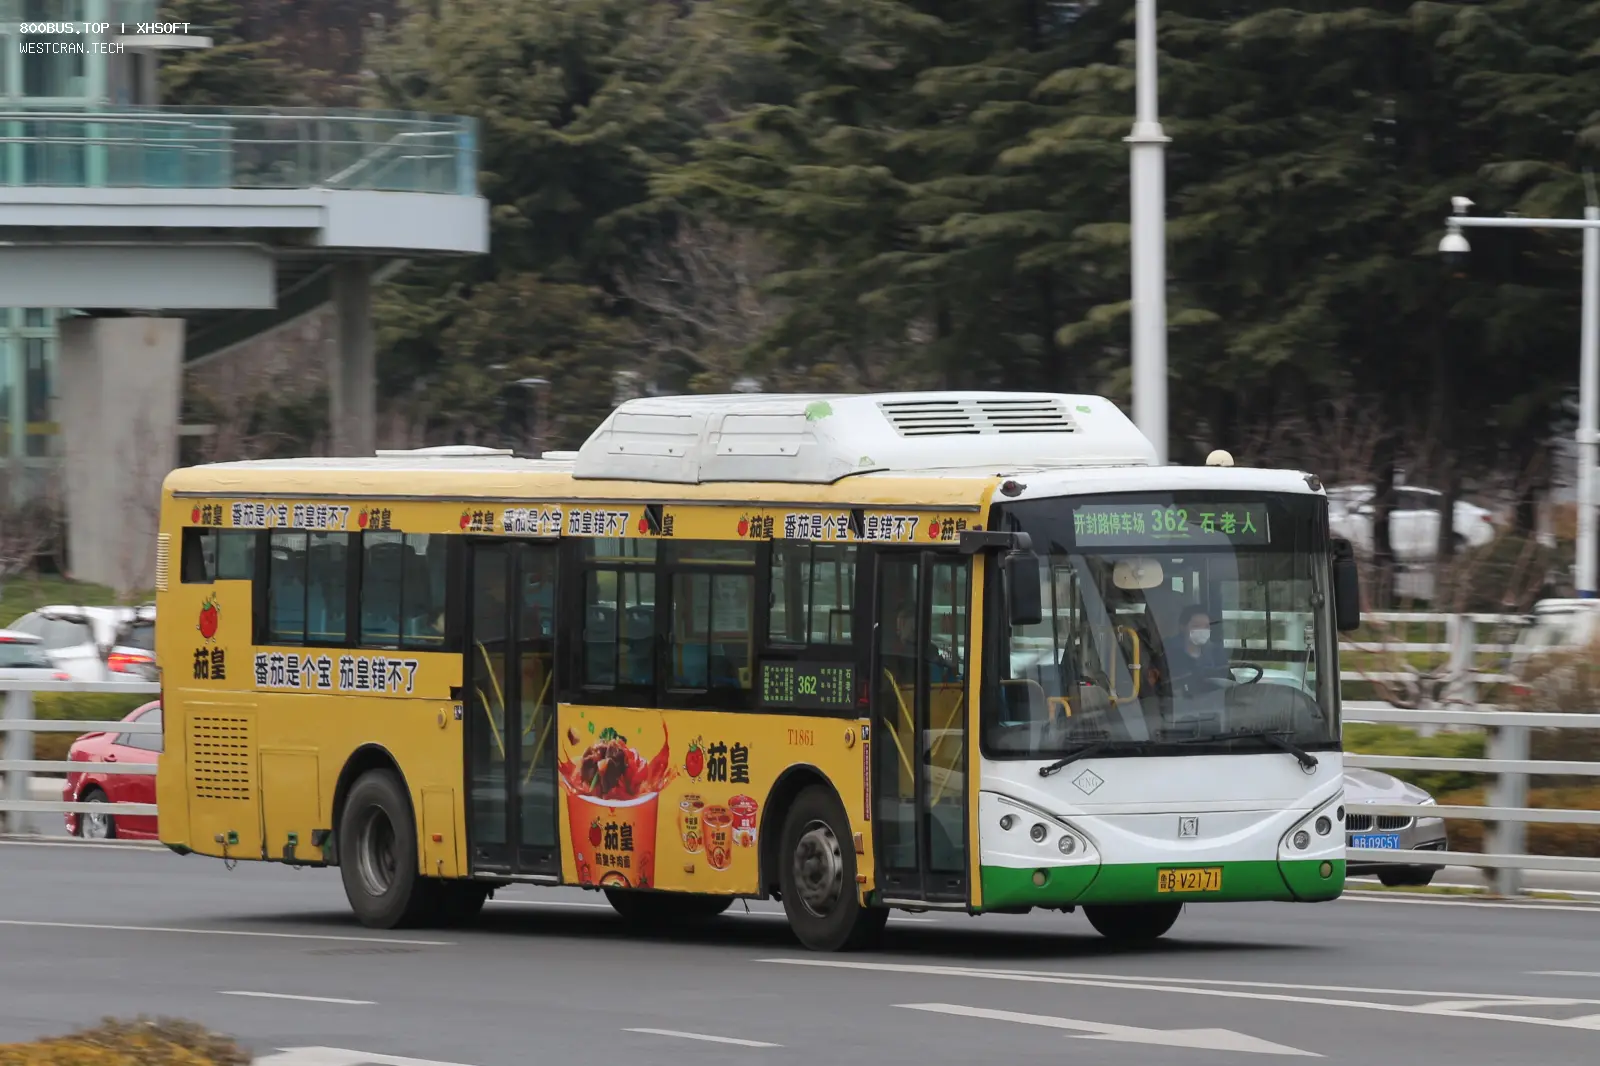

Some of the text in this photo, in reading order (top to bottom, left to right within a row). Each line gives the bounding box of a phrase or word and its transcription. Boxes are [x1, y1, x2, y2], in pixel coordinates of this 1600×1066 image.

[568, 511, 629, 535] 茄皇错不了
[749, 515, 774, 539] 茄皇
[784, 514, 849, 539] 番茄是个宝
[1074, 508, 1257, 535] 开封路停车场 362 石老人
[193, 646, 227, 680] 茄皇
[254, 654, 418, 692] 番茄是个宝 茄皇错不了
[797, 676, 818, 695] 362
[788, 728, 815, 746] T1861
[706, 740, 751, 785] 茄皇
[604, 821, 635, 852] 茄皇
